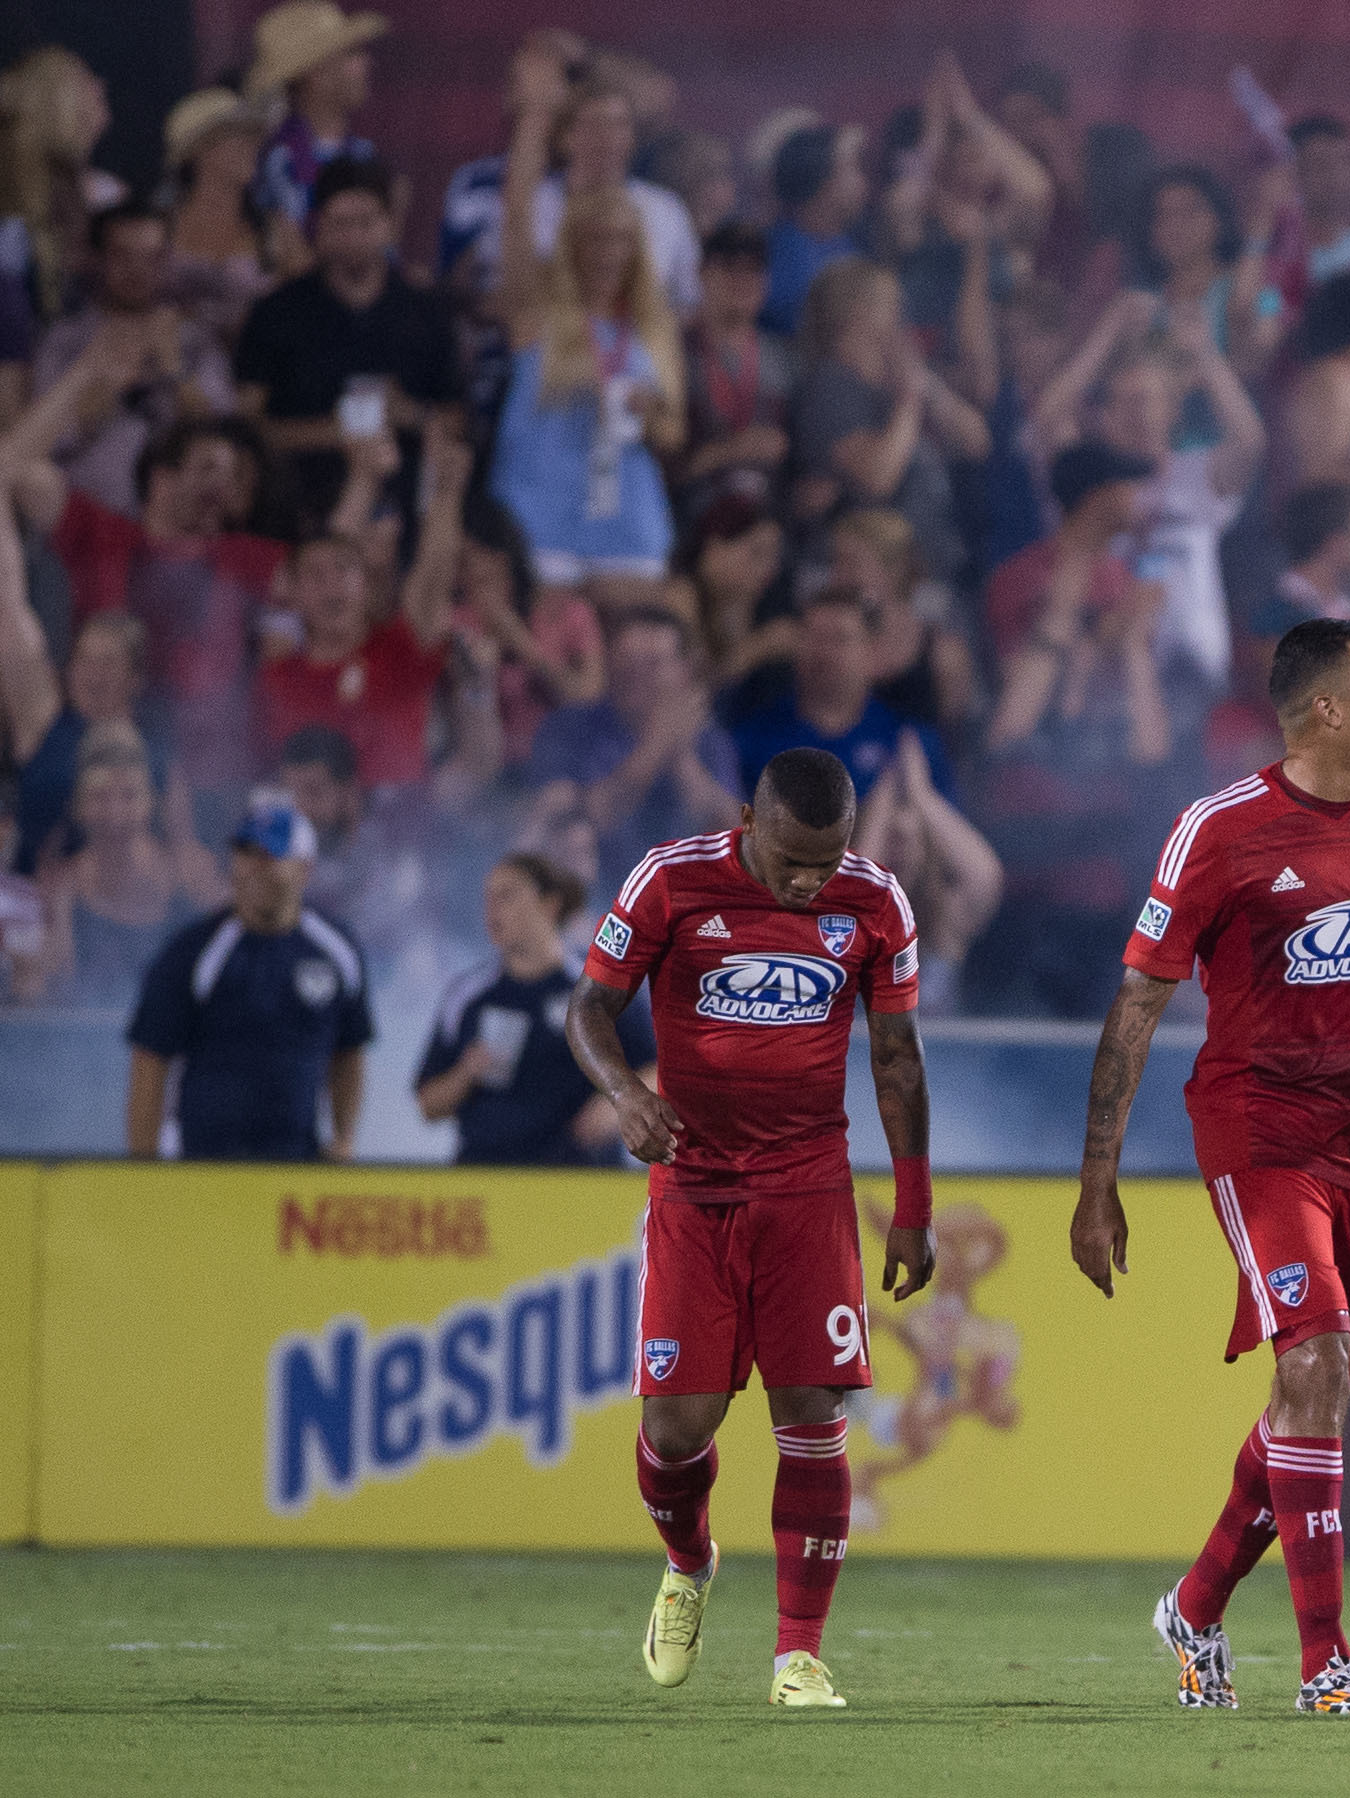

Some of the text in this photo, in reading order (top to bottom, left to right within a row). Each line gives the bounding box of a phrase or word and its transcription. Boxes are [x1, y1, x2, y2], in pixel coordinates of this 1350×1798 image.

[1271, 880, 1306, 892] adidas
[821, 917, 854, 929] FC DALLAS
[1138, 920, 1162, 937] MLS
[697, 928, 732, 938] adidas
[597, 935, 623, 956] MLS
[701, 997, 828, 1020] ADVOCARE
[1270, 1265, 1304, 1285] FC DALLAS
[654, 1341, 675, 1352] DALLAS
[274, 1248, 641, 1510] Nesqu
